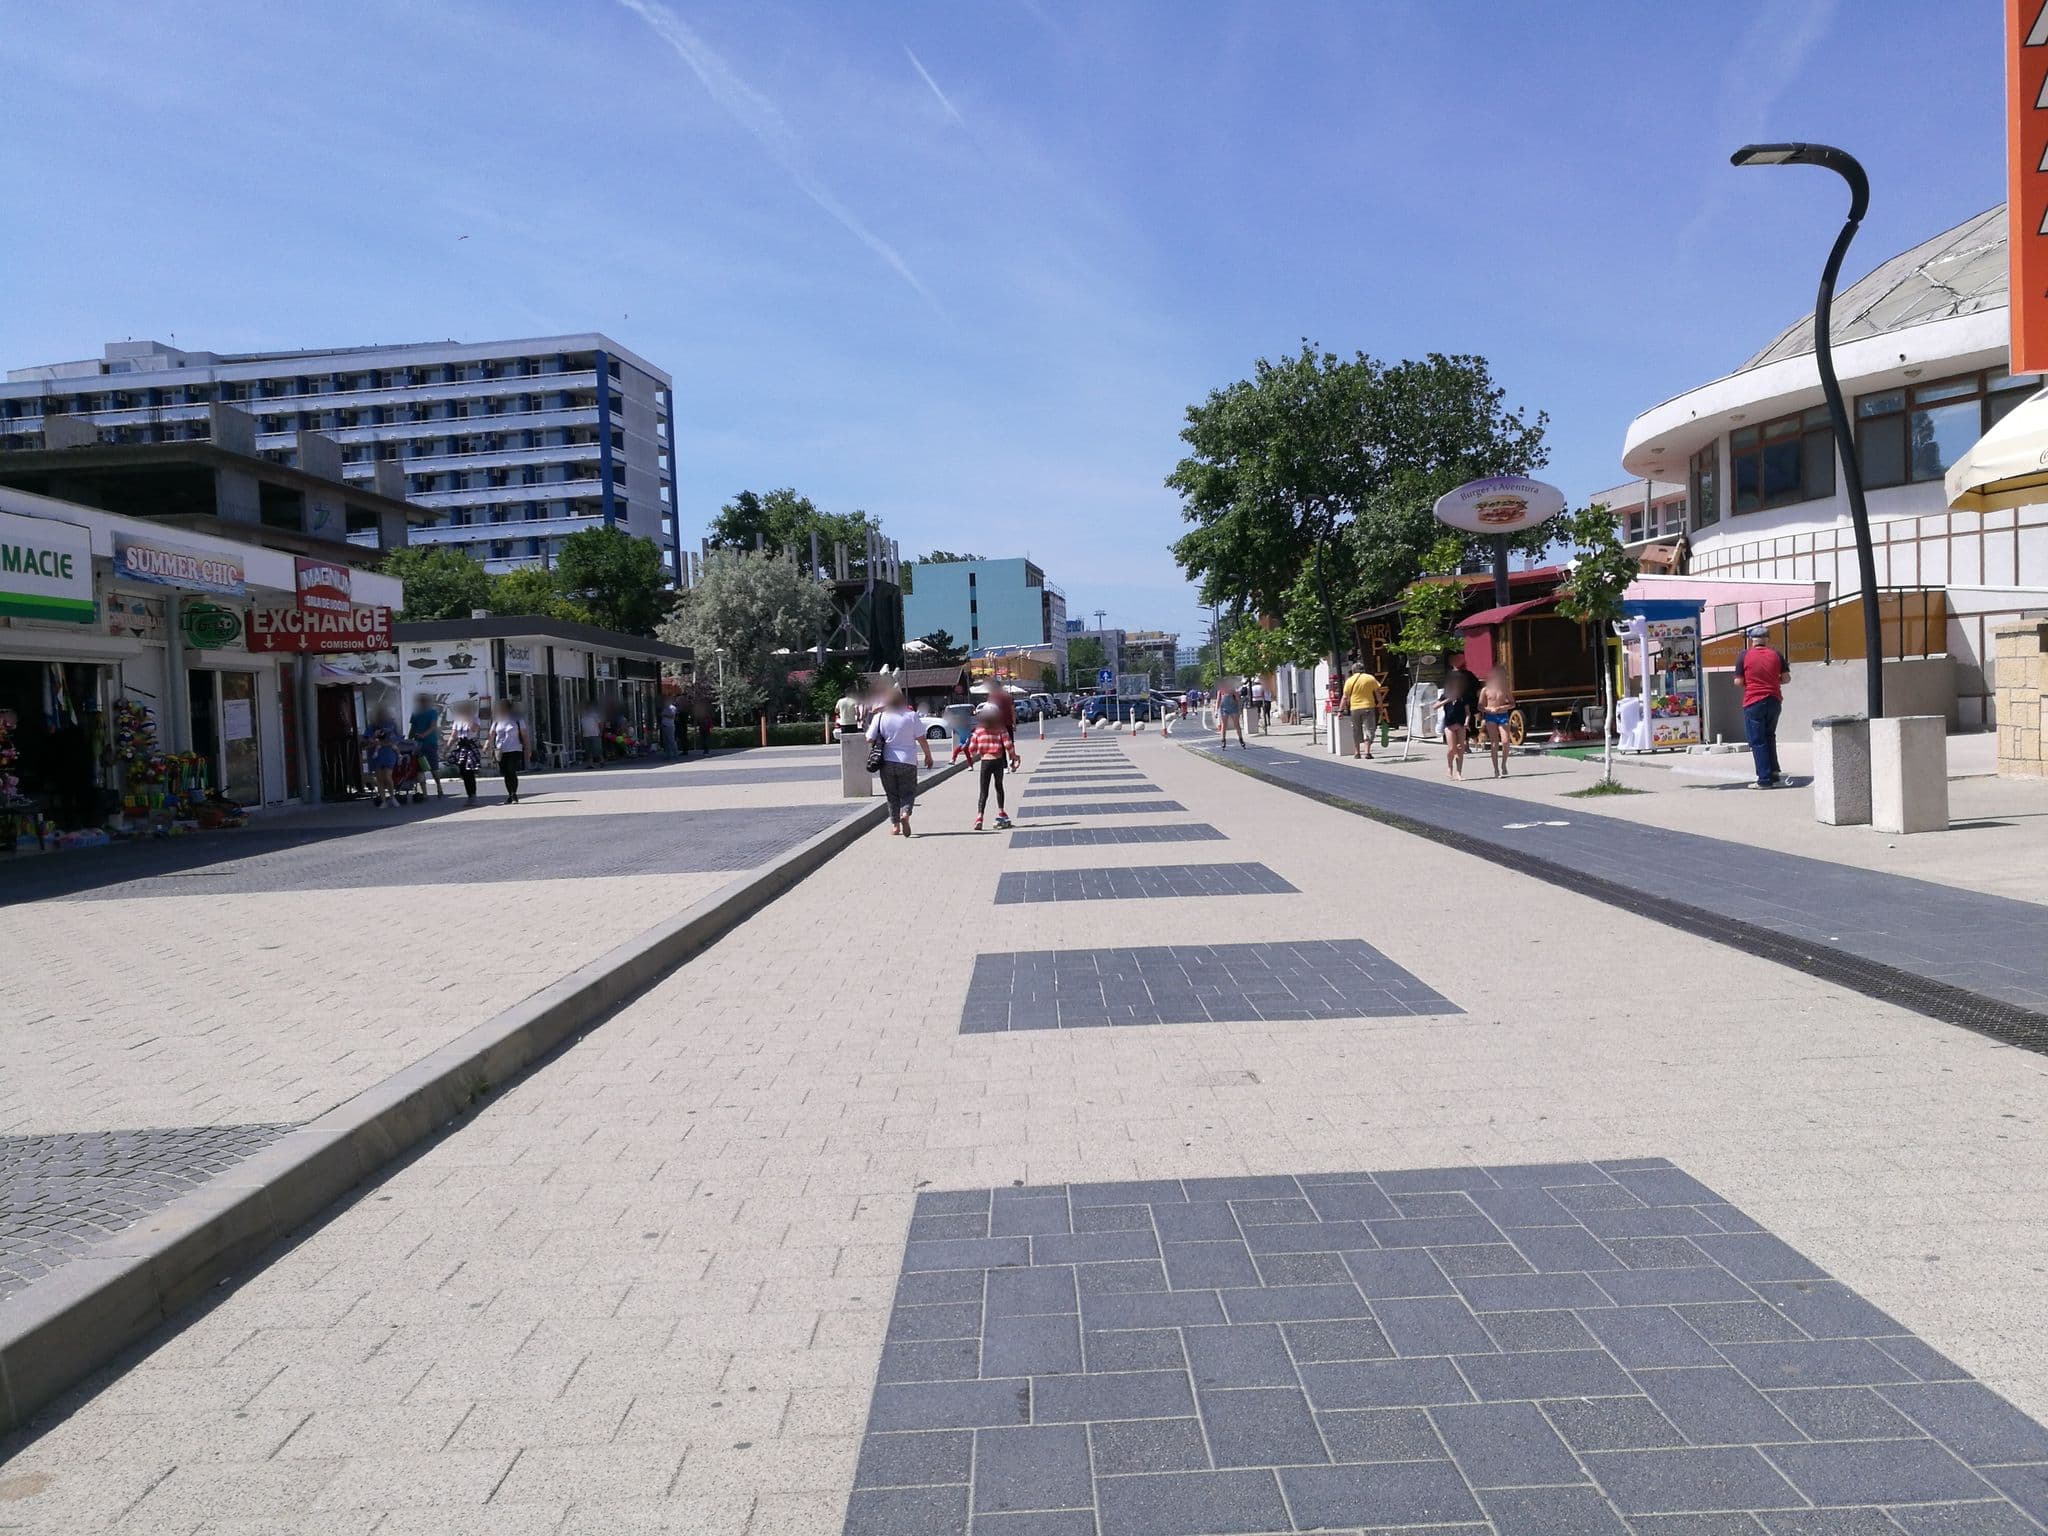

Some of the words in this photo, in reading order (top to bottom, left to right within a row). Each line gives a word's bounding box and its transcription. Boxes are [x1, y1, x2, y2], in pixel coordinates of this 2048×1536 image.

[1459, 484, 1497, 501] Burger's
[1499, 482, 1539, 494] Aventura
[126, 545, 200, 580] SUMMER
[202, 559, 238, 587] CHIC
[299, 567, 352, 594] MAGNUM
[252, 608, 388, 634] EXCHANGE
[320, 640, 364, 649] COMISION
[366, 634, 389, 649] 0%
[411, 646, 432, 654] TIME
